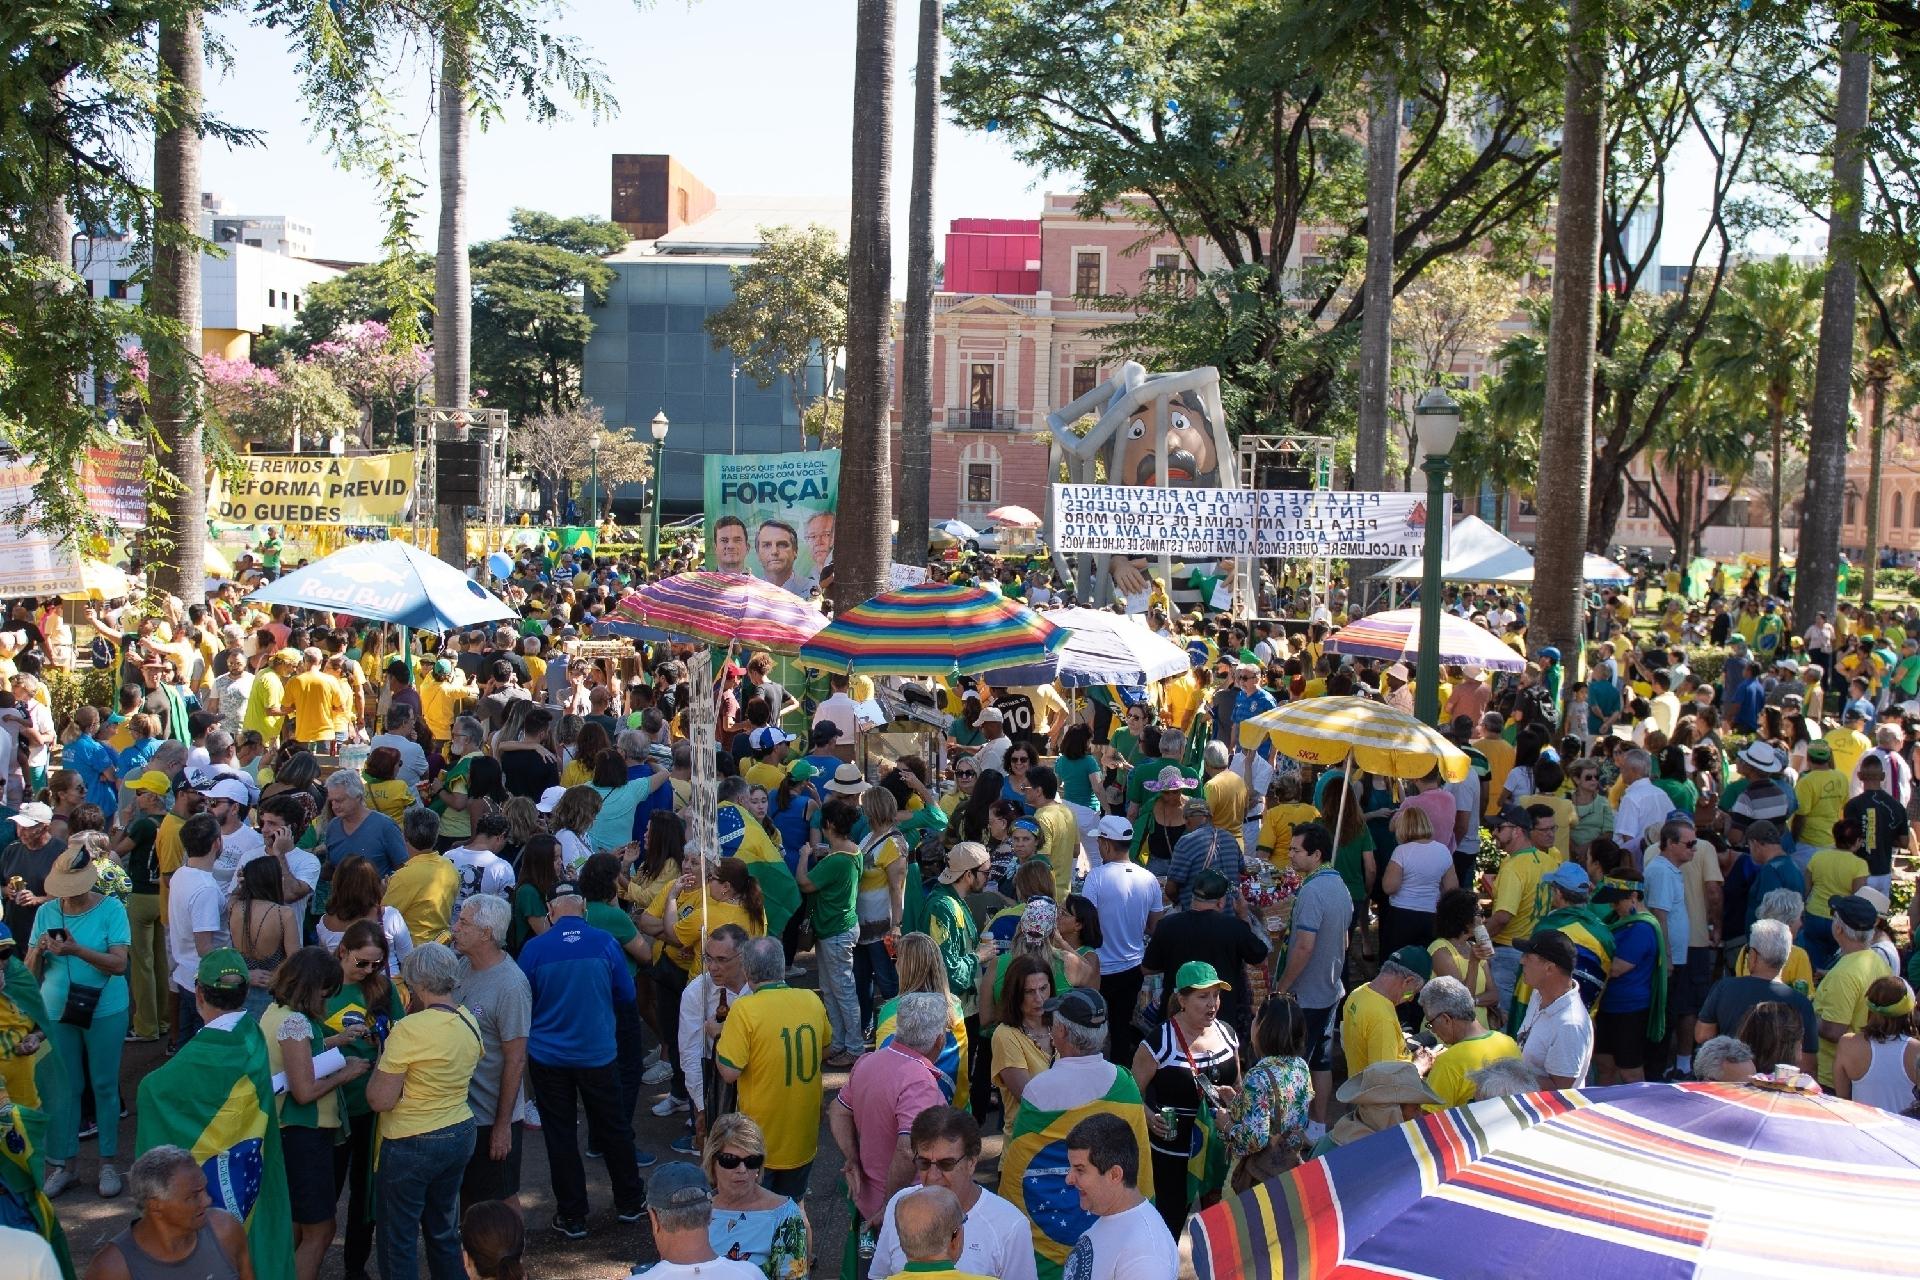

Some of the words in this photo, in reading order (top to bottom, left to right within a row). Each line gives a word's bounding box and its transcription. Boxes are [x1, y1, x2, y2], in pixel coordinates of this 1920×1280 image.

[327, 461, 341, 476] A
[721, 465, 757, 473] SABEMOS
[757, 464, 775, 472] QUE
[776, 461, 795, 471] NÃO
[775, 471, 795, 479] COM
[220, 478, 322, 497] REFORMA
[721, 476, 829, 509] FORÇA!
[220, 502, 247, 521] DO
[254, 503, 341, 523] GUEDES
[298, 577, 356, 603] Red
[352, 586, 409, 613] Bull
[1003, 706, 1031, 734] 10
[780, 1024, 818, 1088] 10
